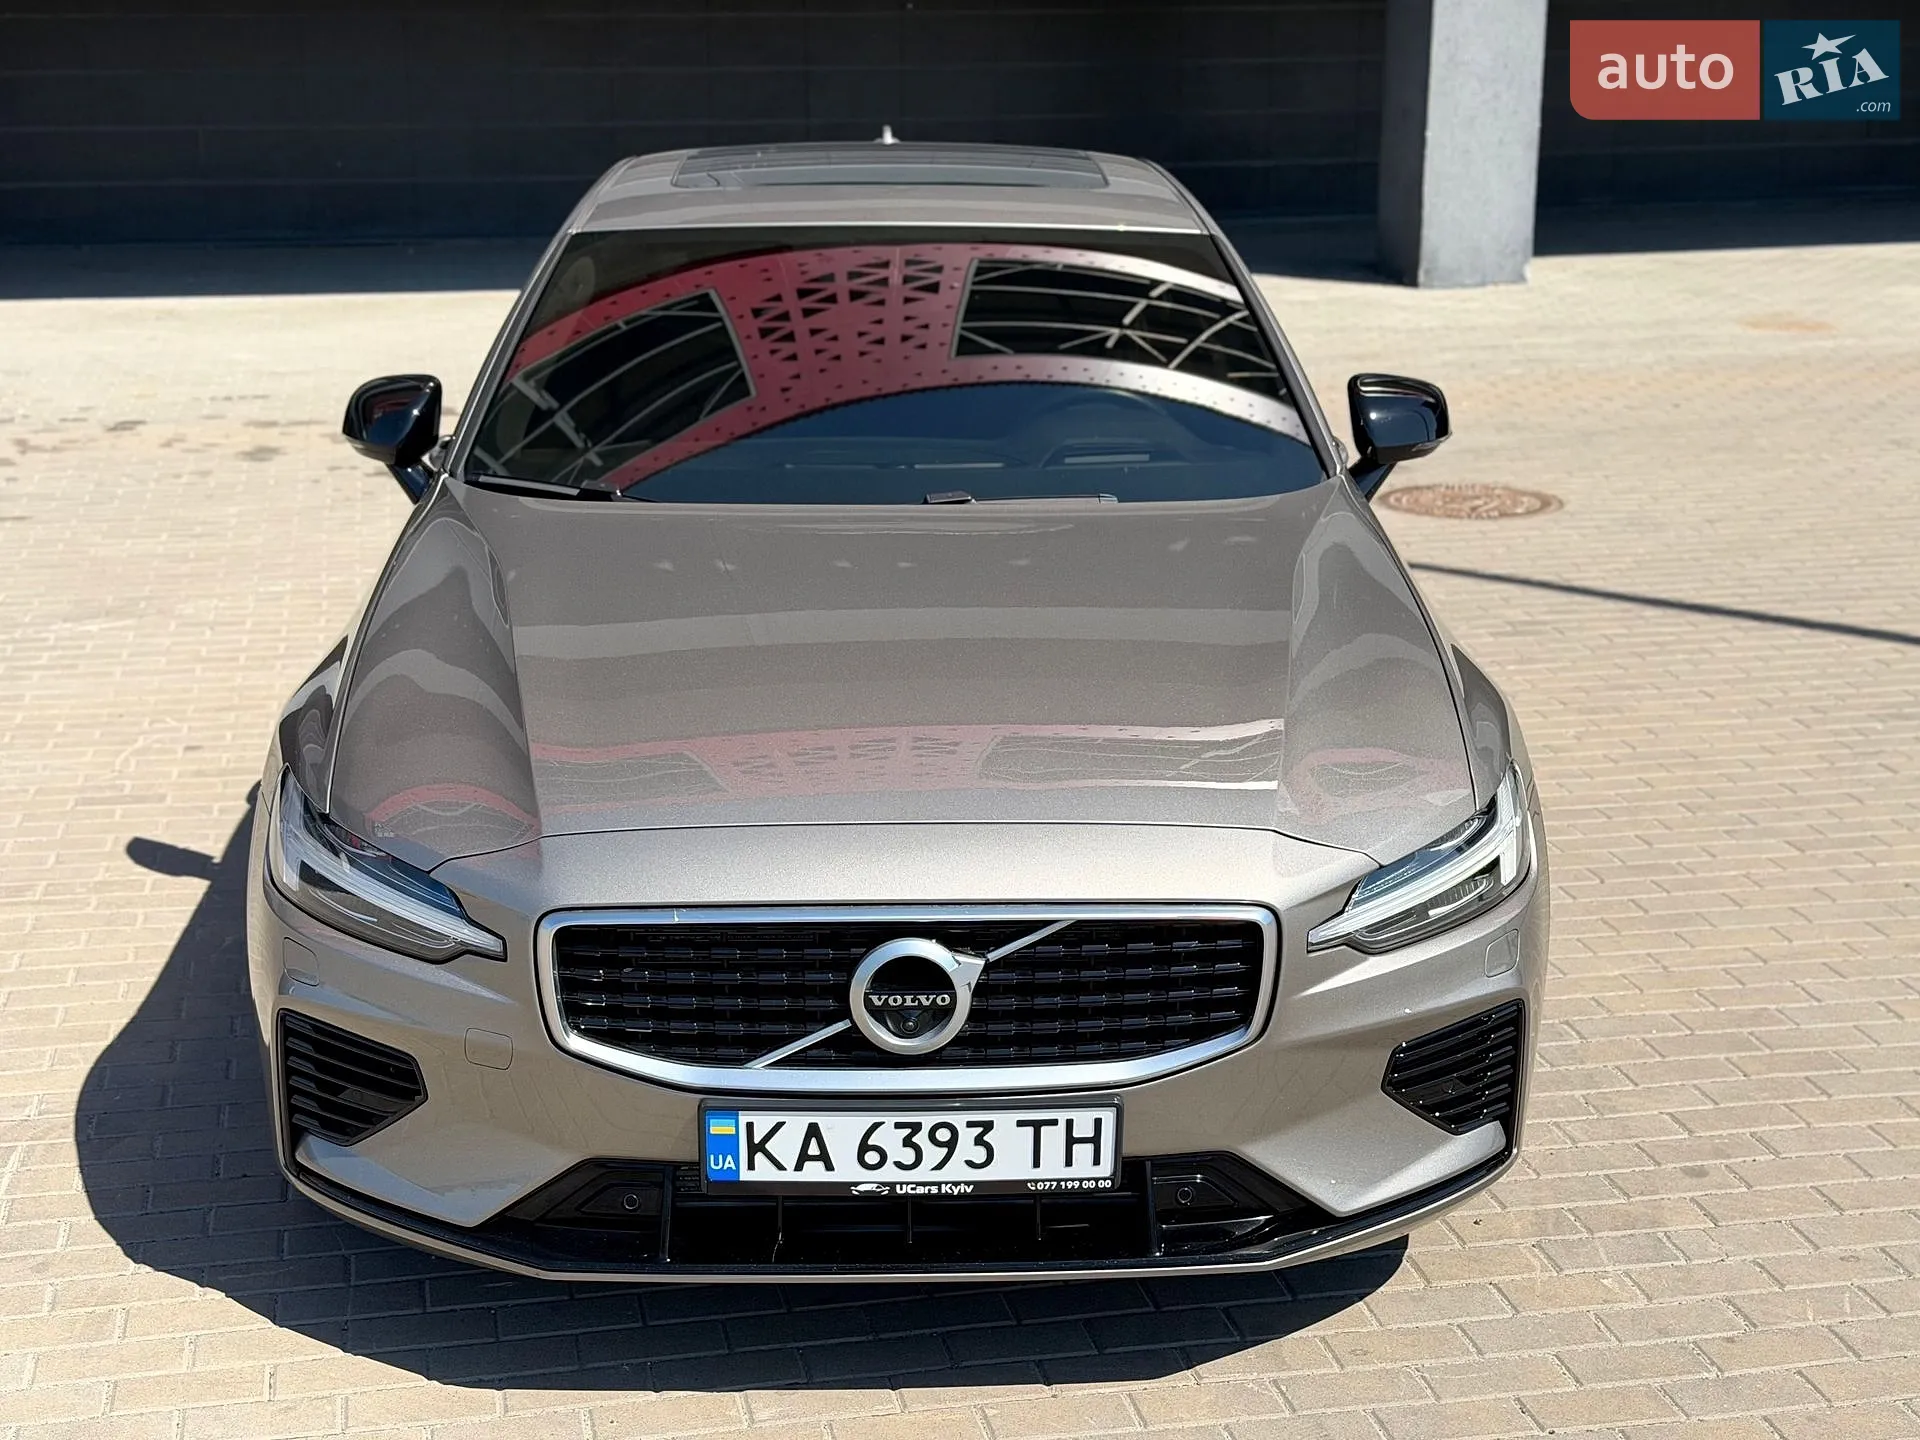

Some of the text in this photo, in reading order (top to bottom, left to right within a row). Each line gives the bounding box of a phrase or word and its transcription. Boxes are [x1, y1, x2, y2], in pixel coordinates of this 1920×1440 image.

[868, 994, 951, 1006] VOLVO
[745, 1117, 1103, 1171] KA 6393 TH
[710, 1154, 736, 1170] UA
[896, 1183, 974, 1195] UCars Kyiv
[1036, 1180, 1112, 1191] 077 199 00 00
